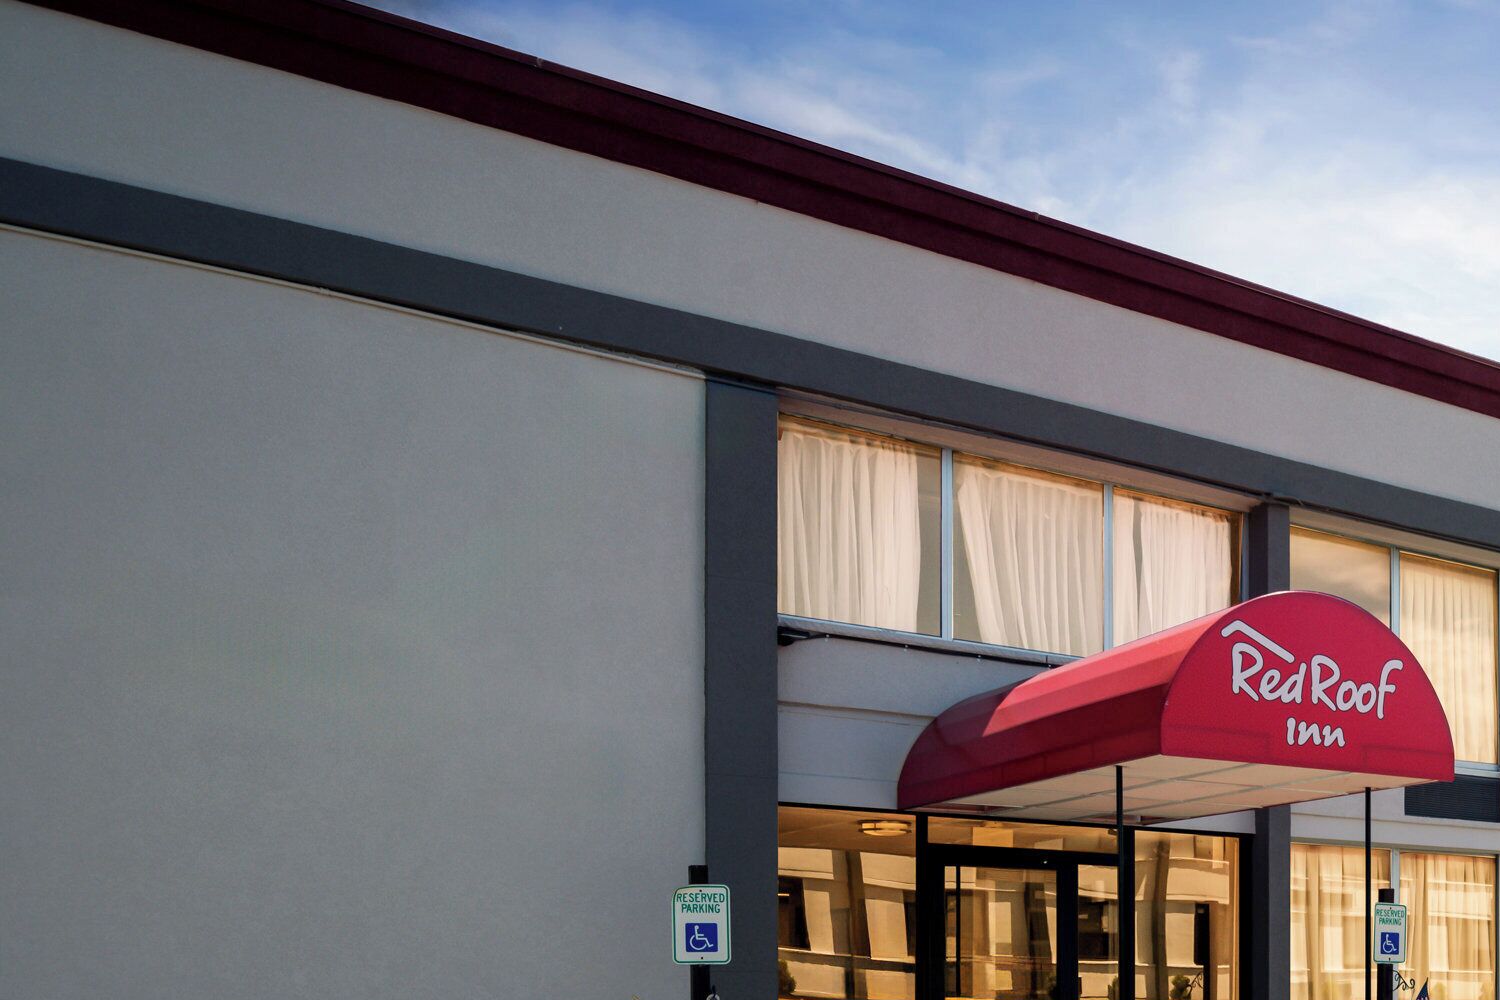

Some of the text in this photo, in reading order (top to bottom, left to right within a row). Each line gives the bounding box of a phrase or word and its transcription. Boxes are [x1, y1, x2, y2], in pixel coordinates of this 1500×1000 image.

[1231, 642, 1403, 720] Red Roof
[676, 893, 726, 903] RESERVED
[681, 904, 721, 913] PARKING
[1376, 909, 1404, 918] RESERVED
[1379, 917, 1402, 925] PARKING
